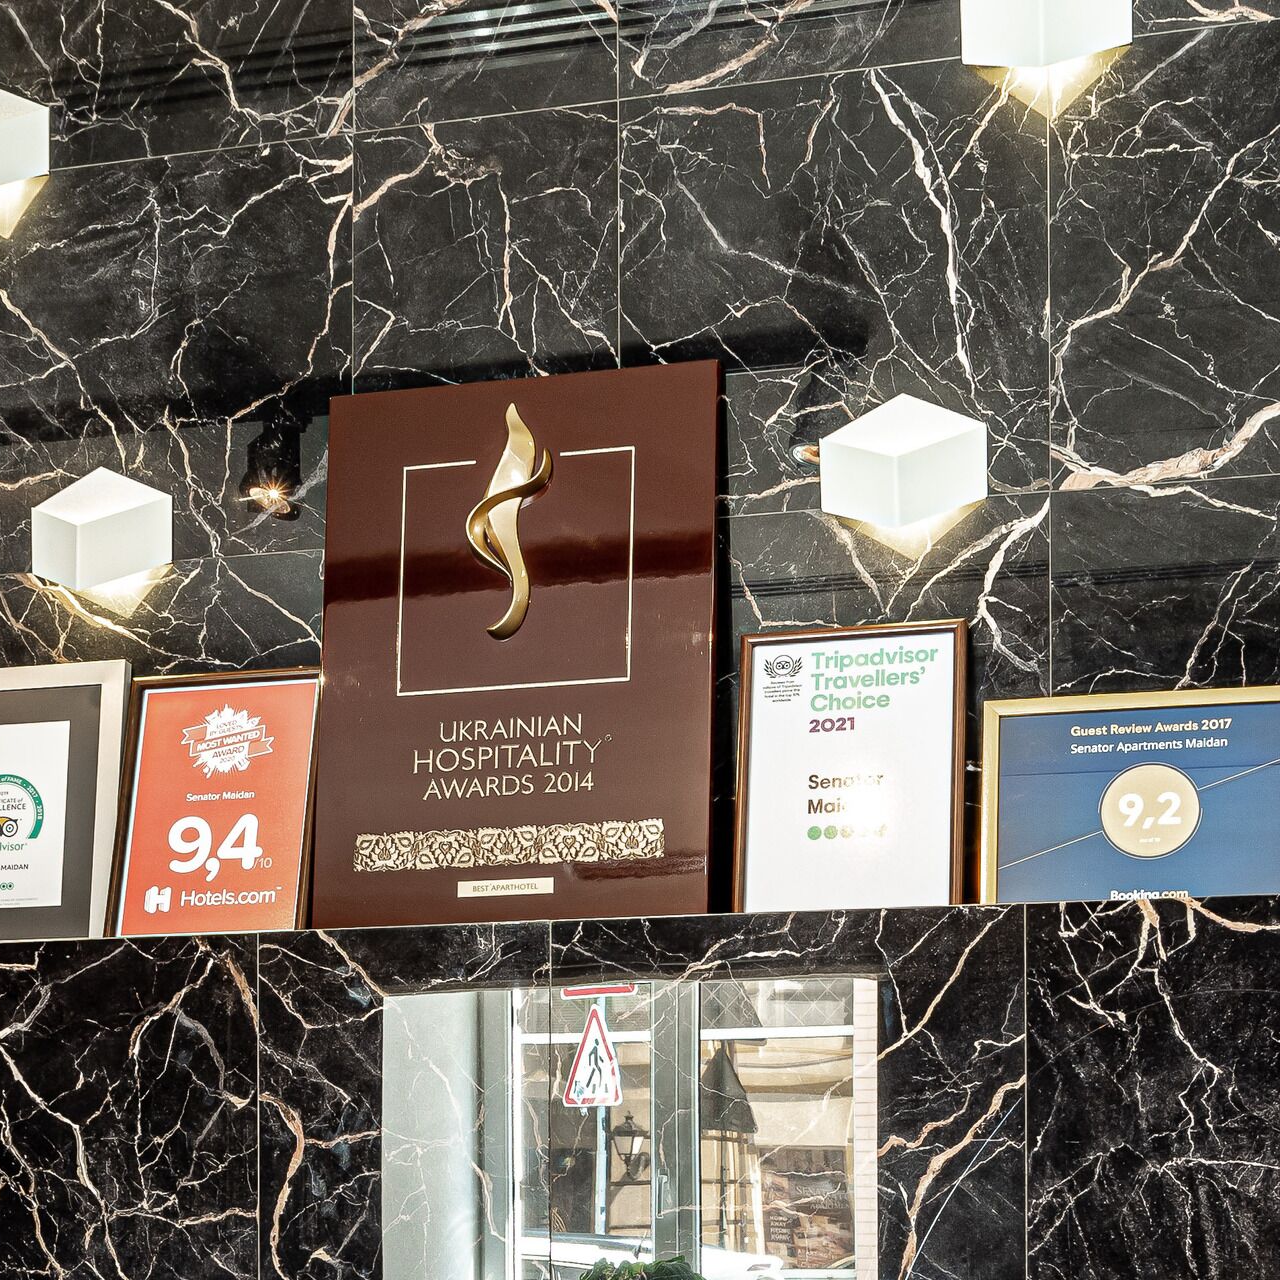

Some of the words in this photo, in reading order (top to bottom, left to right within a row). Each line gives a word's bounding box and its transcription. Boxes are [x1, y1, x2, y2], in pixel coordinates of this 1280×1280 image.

[811, 646, 939, 672] Tripadvisor
[810, 691, 891, 712] Choice
[439, 713, 583, 743] UKRAINIAN
[809, 717, 855, 733] 2021
[1070, 725, 1108, 737] Guest
[1110, 723, 1152, 735] Review
[1155, 721, 1199, 733] Awards
[1201, 718, 1233, 730] 2017
[196, 739, 222, 752] MOST
[222, 730, 261, 745] WANTED
[1070, 742, 1114, 754] Senator
[1116, 740, 1183, 753] Apartments
[1185, 737, 1229, 750] Maidan
[211, 745, 245, 758] AWARD
[413, 739, 603, 775] HOSPITALITY
[7, 776, 23, 784] FAME
[422, 774, 535, 801] AWARDS
[543, 770, 595, 793] 2014
[186, 792, 221, 802] Senator
[222, 790, 256, 800] Maidan
[1118, 791, 1182, 830] 9,2
[0, 863, 29, 871] MAIDAN
[472, 884, 489, 893] BEST
[490, 883, 539, 892] APARTHOTEL
[180, 889, 277, 907] Hotels.com
